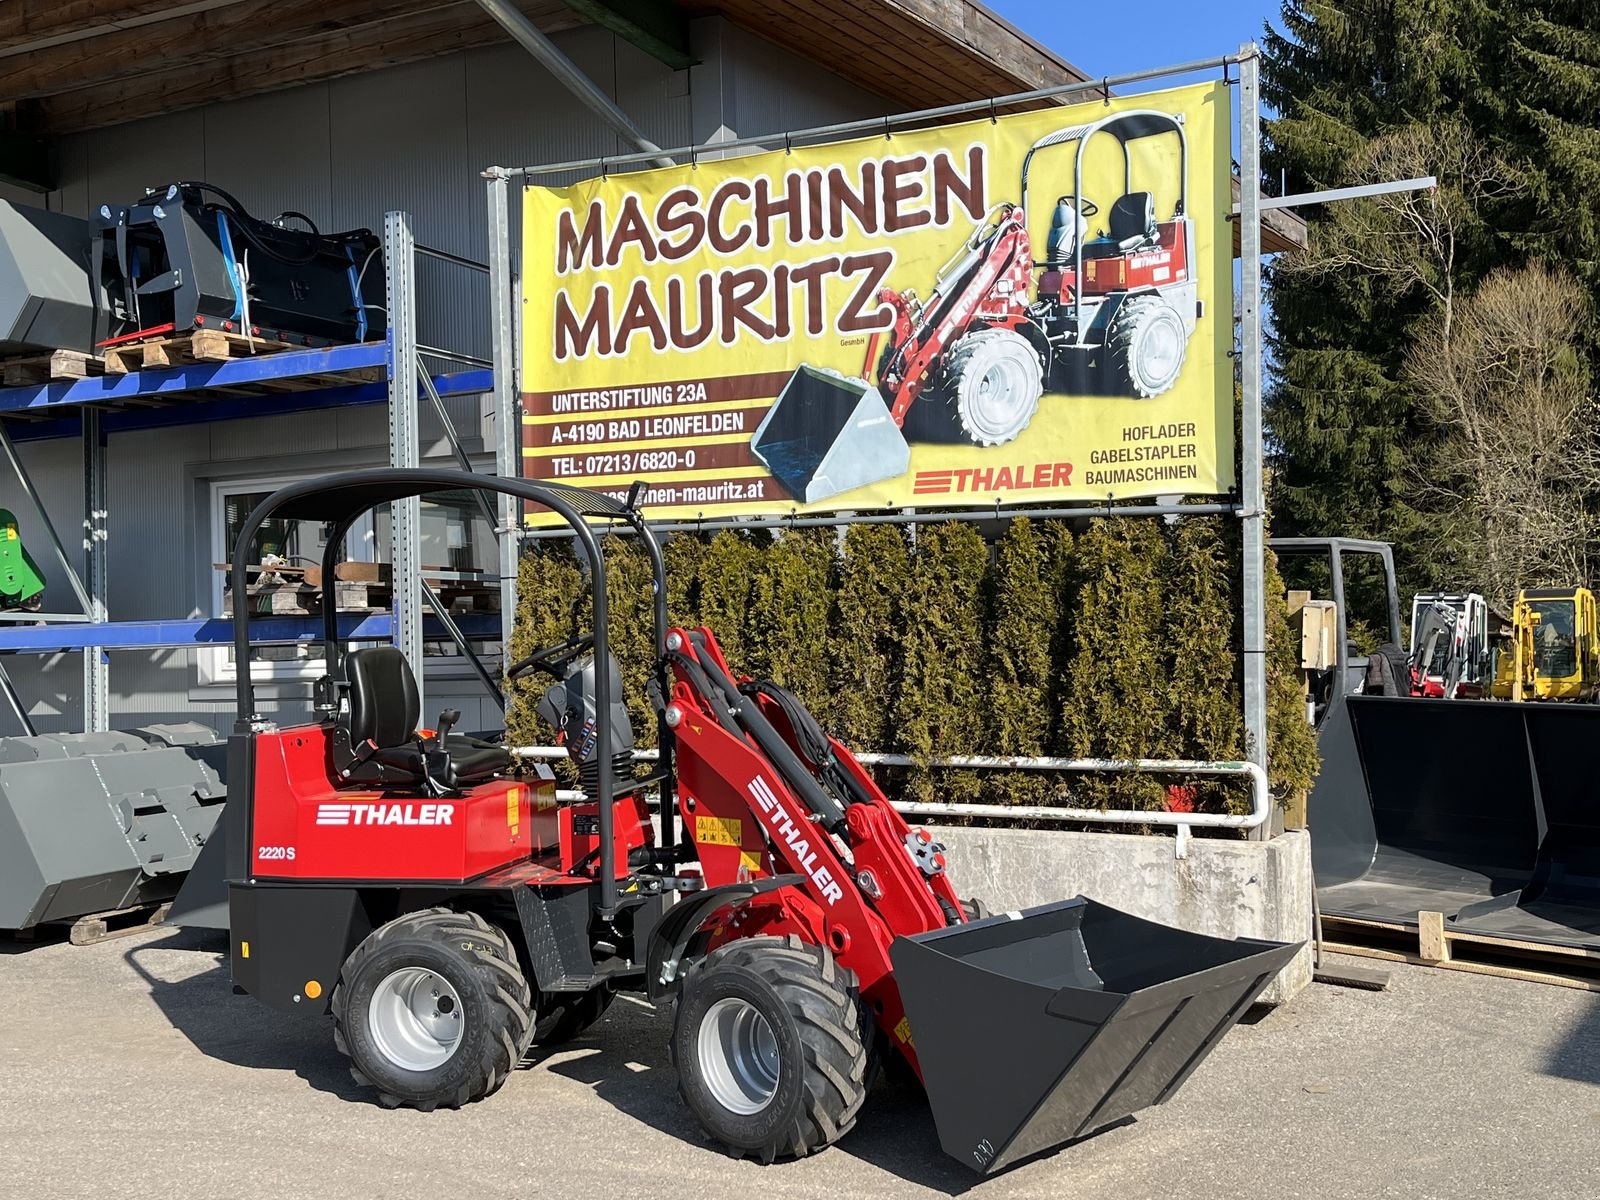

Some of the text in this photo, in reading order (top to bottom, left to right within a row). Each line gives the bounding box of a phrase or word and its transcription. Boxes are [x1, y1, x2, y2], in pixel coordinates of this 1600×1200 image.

[557, 146, 986, 274] MASCHINEN
[555, 251, 897, 359] MAURITZ
[840, 337, 865, 346] GesmbH
[552, 382, 707, 412] UNTERSTIFTUNG 23A
[552, 412, 744, 443] A-4190 BAD LEONFELDEN
[1123, 422, 1196, 441] HOFLADER
[552, 450, 696, 475] TEL: 07213/6820-0
[1090, 443, 1196, 464] GABELSTAPLER
[954, 462, 1073, 492] THALER
[1085, 464, 1197, 485] BAUMASCHINEN
[349, 804, 454, 825] THALER
[258, 846, 296, 860] 2220 S
[770, 802, 843, 906] THALER
